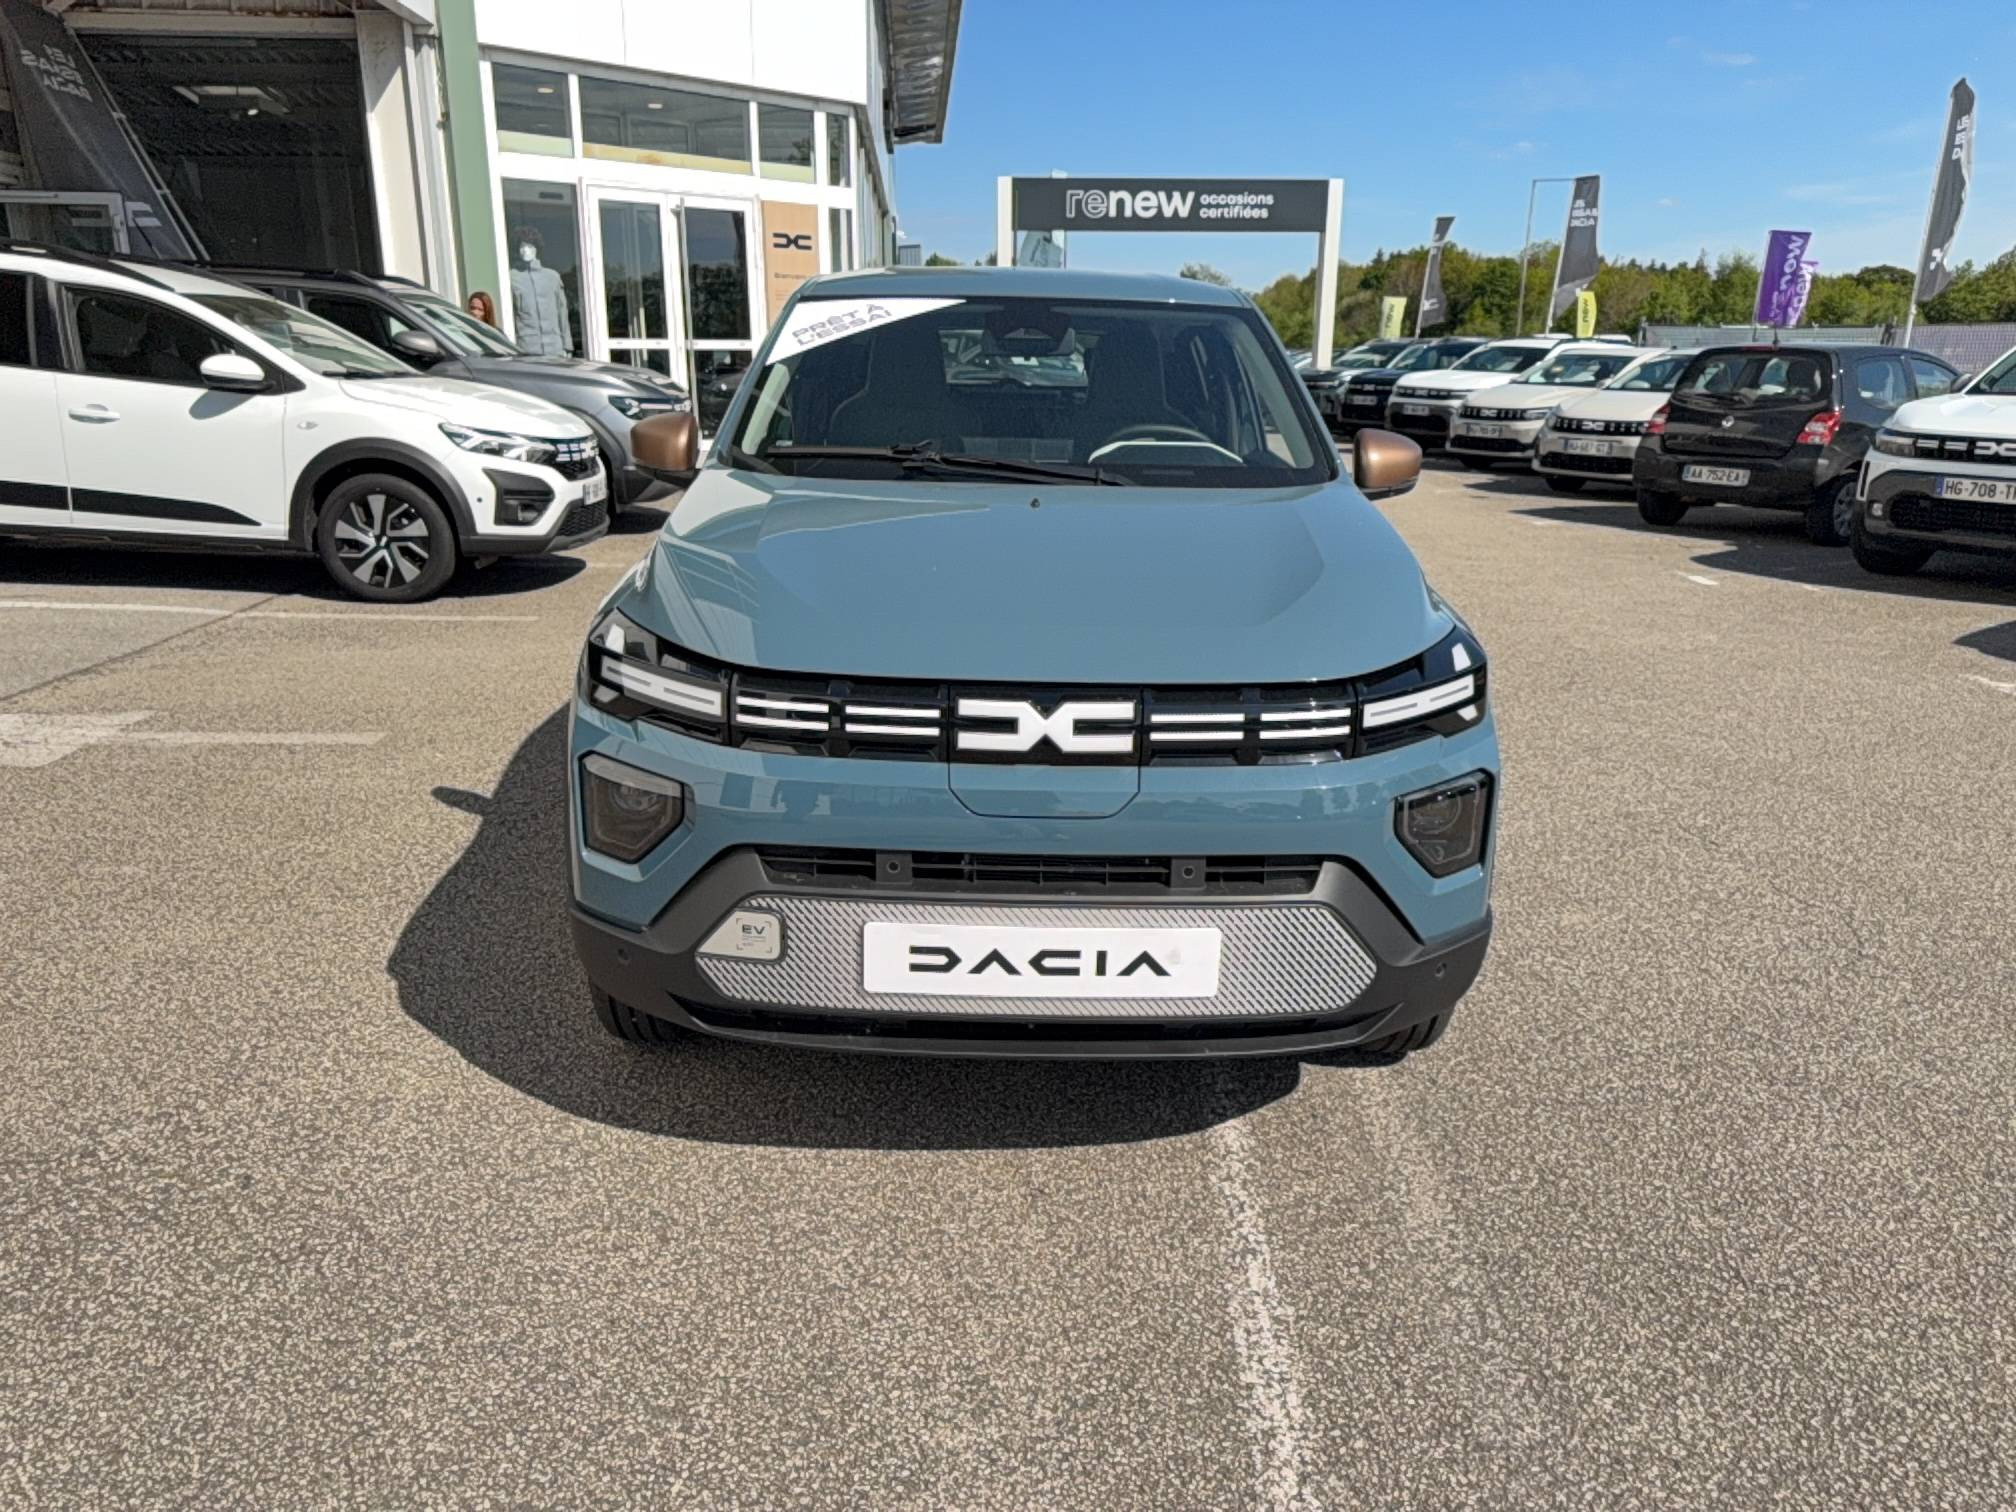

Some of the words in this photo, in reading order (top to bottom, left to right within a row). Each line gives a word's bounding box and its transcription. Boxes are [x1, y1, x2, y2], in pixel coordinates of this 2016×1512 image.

[1066, 190, 1195, 218] renew
[1200, 192, 1274, 205] occasions
[1200, 205, 1269, 219] certifiées
[797, 310, 892, 346] L'ESSAI
[741, 924, 766, 935] EV
[909, 944, 1172, 977] DACIA
